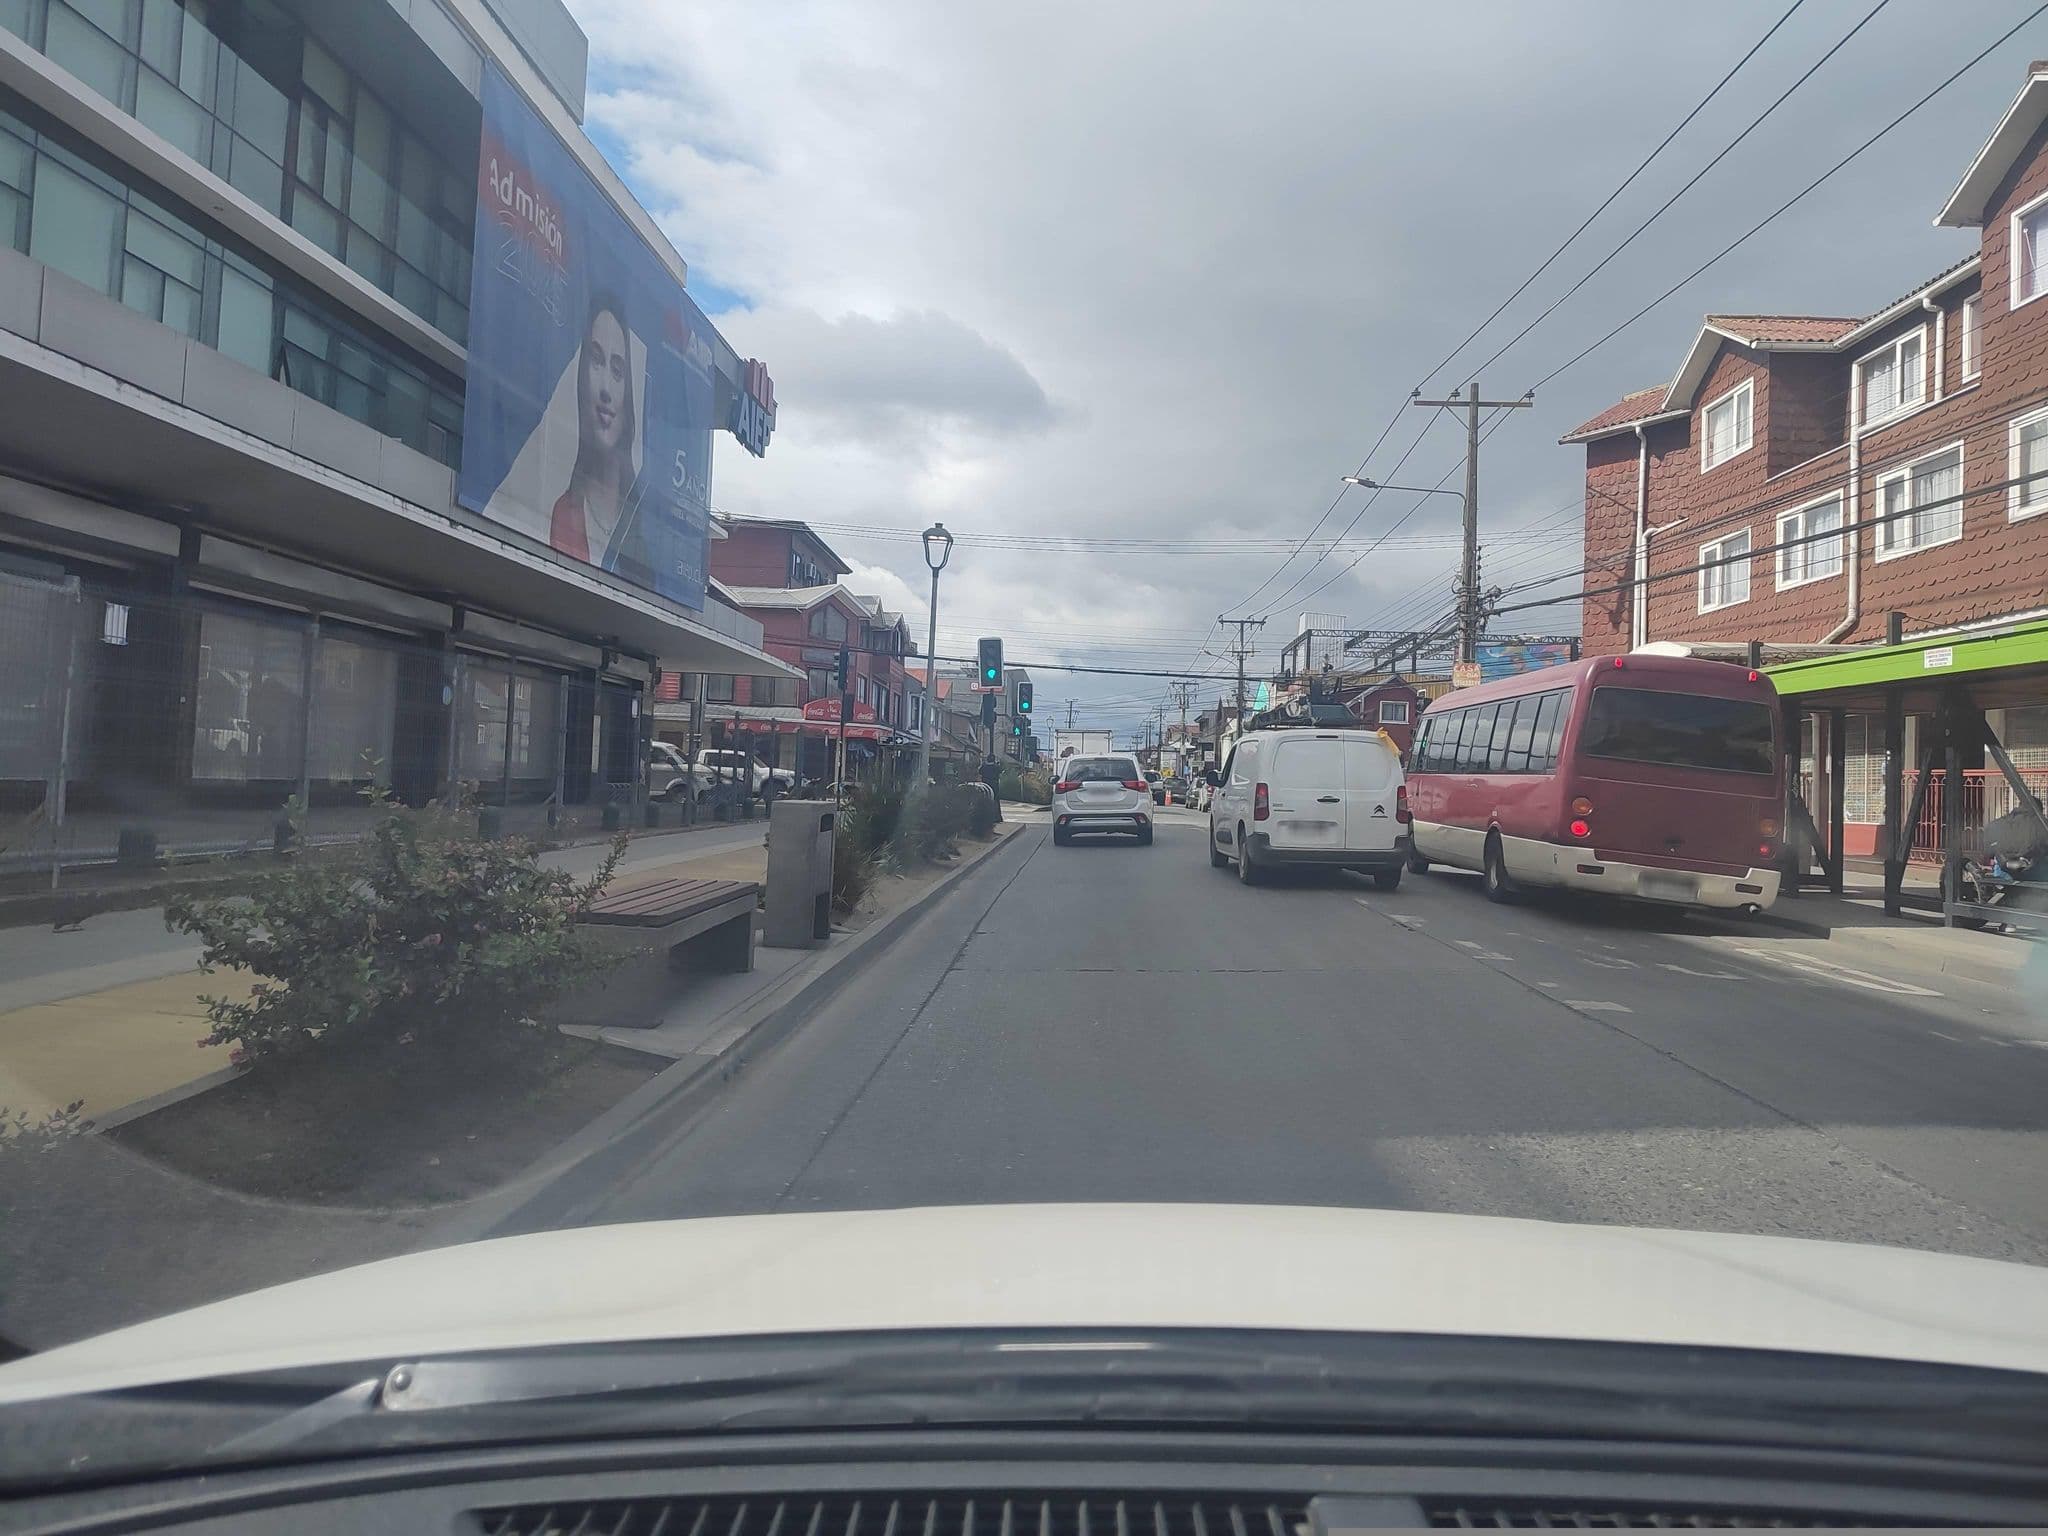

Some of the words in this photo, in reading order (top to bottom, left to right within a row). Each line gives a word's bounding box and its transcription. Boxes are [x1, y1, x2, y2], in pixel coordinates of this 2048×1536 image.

[489, 157, 563, 257] Admisión
[737, 391, 771, 455] AIEP
[672, 449, 687, 488] 5
